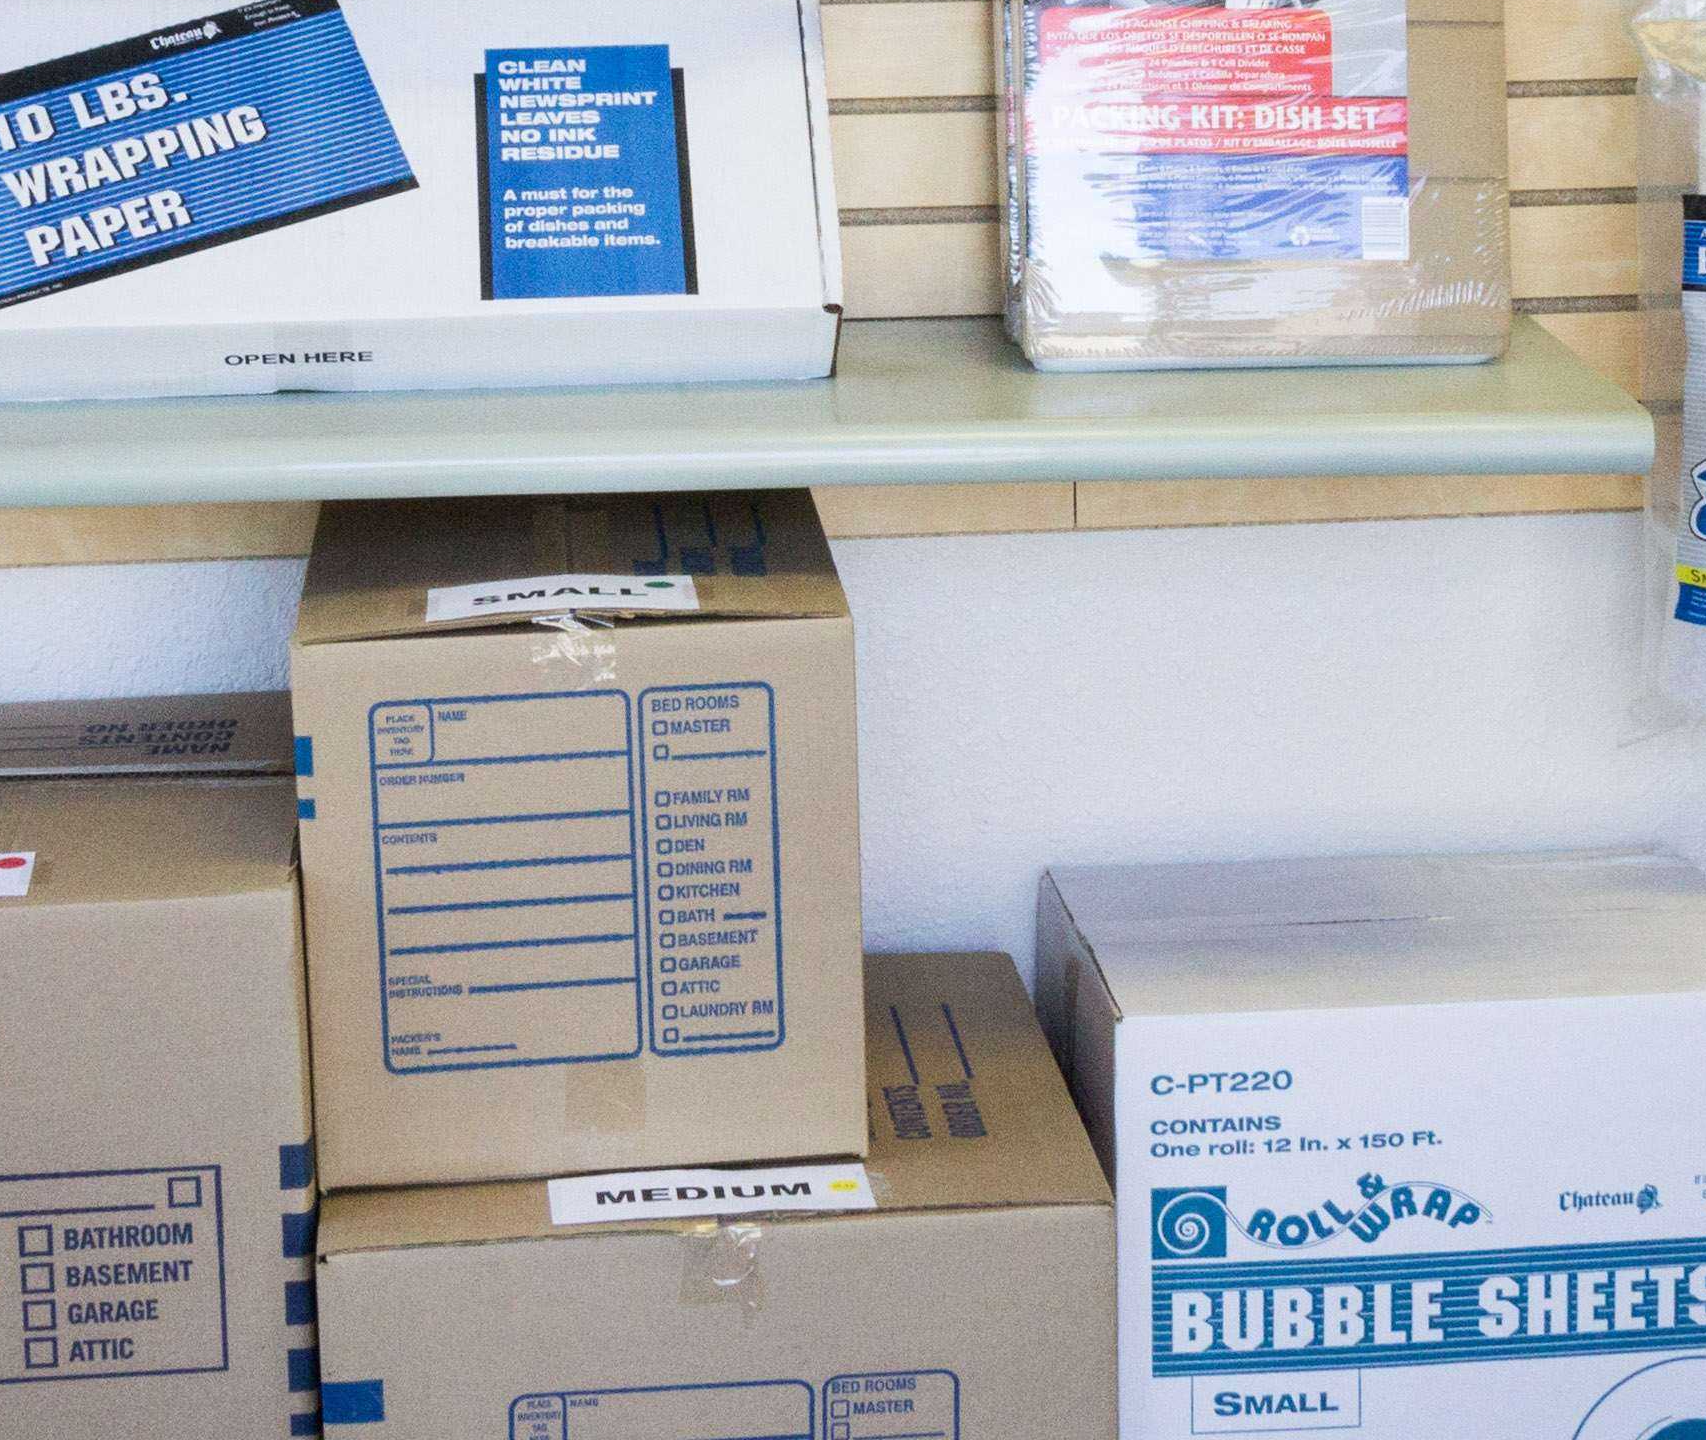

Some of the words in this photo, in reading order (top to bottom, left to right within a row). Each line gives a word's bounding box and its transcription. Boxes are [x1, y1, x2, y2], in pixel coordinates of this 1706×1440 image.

[149, 24, 203, 53] Chateau
[498, 59, 586, 74] CLEAN
[499, 77, 581, 91] WHITE
[74, 70, 189, 135] LBS.
[500, 91, 658, 109] NEWSPRINT
[501, 110, 600, 126] LEAVES
[1052, 103, 1181, 130] PACKING
[1191, 105, 1246, 130] KIT:
[1255, 105, 1320, 130] DISH
[1333, 106, 1380, 130] SET
[501, 130, 541, 143] NO
[549, 128, 597, 142] INK
[2, 104, 270, 208] WRAPPING
[502, 145, 620, 161] RESIDUE
[503, 190, 517, 201] A
[521, 188, 567, 200] must
[572, 187, 598, 199] for
[603, 186, 633, 198] the
[504, 206, 567, 219] proper
[572, 202, 645, 217] packing
[23, 190, 192, 266] PAPER
[224, 351, 295, 367] OPEN
[303, 348, 374, 365] HERE
[473, 583, 646, 605] SMALL
[651, 698, 681, 712] BED
[685, 696, 739, 710] ROOMS
[670, 718, 730, 734] MASTER
[673, 790, 722, 805] FAMILY
[726, 788, 750, 802] RM
[676, 861, 725, 876] DINING
[729, 859, 753, 873] RM
[676, 883, 740, 898] KITCHEN
[1150, 1068, 1292, 1096] C-PT220
[1150, 1115, 1281, 1136] CONTAINS
[1150, 1141, 1201, 1158] One
[1208, 1139, 1255, 1156] roll:
[1263, 1137, 1291, 1154] 12
[1299, 1135, 1328, 1152] In.
[1337, 1139, 1351, 1149] x
[1361, 1132, 1404, 1149] 150
[1413, 1129, 1442, 1146] Ft.
[596, 1181, 811, 1206] MEDIUM
[1559, 1188, 1634, 1213] Chateau
[1245, 1198, 1357, 1244] ROLL
[1347, 1180, 1480, 1244] WRAP
[64, 1223, 194, 1251] BATHROOM
[65, 1261, 194, 1287] BASEMENT
[67, 1299, 158, 1325] GARAGE
[1171, 1277, 1445, 1354] BUBBLE
[69, 1338, 134, 1362] ATTIC
[1214, 1391, 1339, 1416] SMALL
